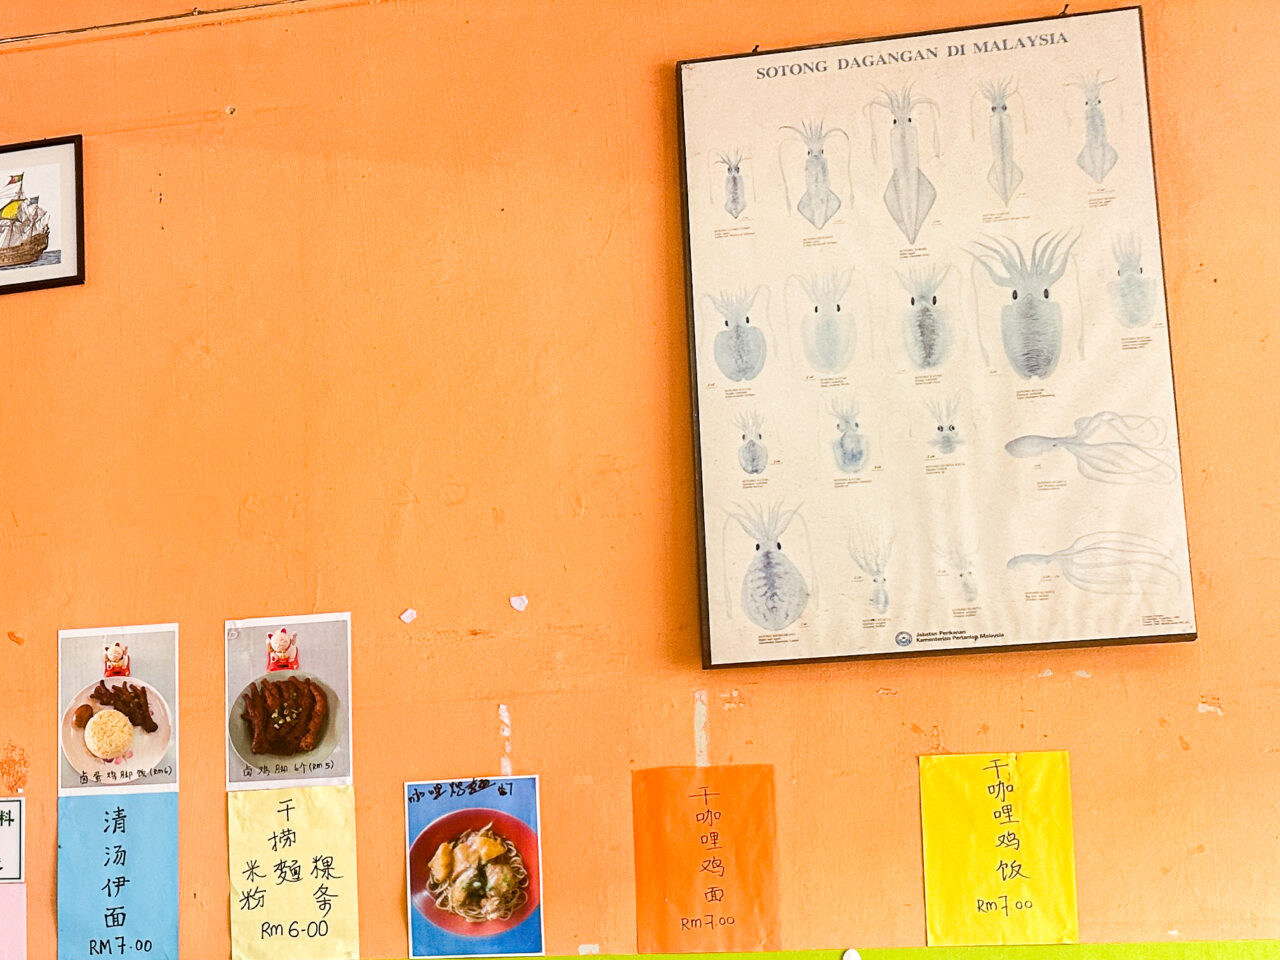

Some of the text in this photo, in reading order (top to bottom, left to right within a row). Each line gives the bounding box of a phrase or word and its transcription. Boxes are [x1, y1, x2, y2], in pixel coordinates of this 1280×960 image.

[756, 32, 1069, 80] SOTONG DAGANGAN DI MALAYSIA
[267, 799, 297, 852] 干捞
[982, 758, 1032, 882] 干咖哩鸡饭
[101, 806, 130, 928] 清汤伊面
[239, 860, 267, 911] 米粉
